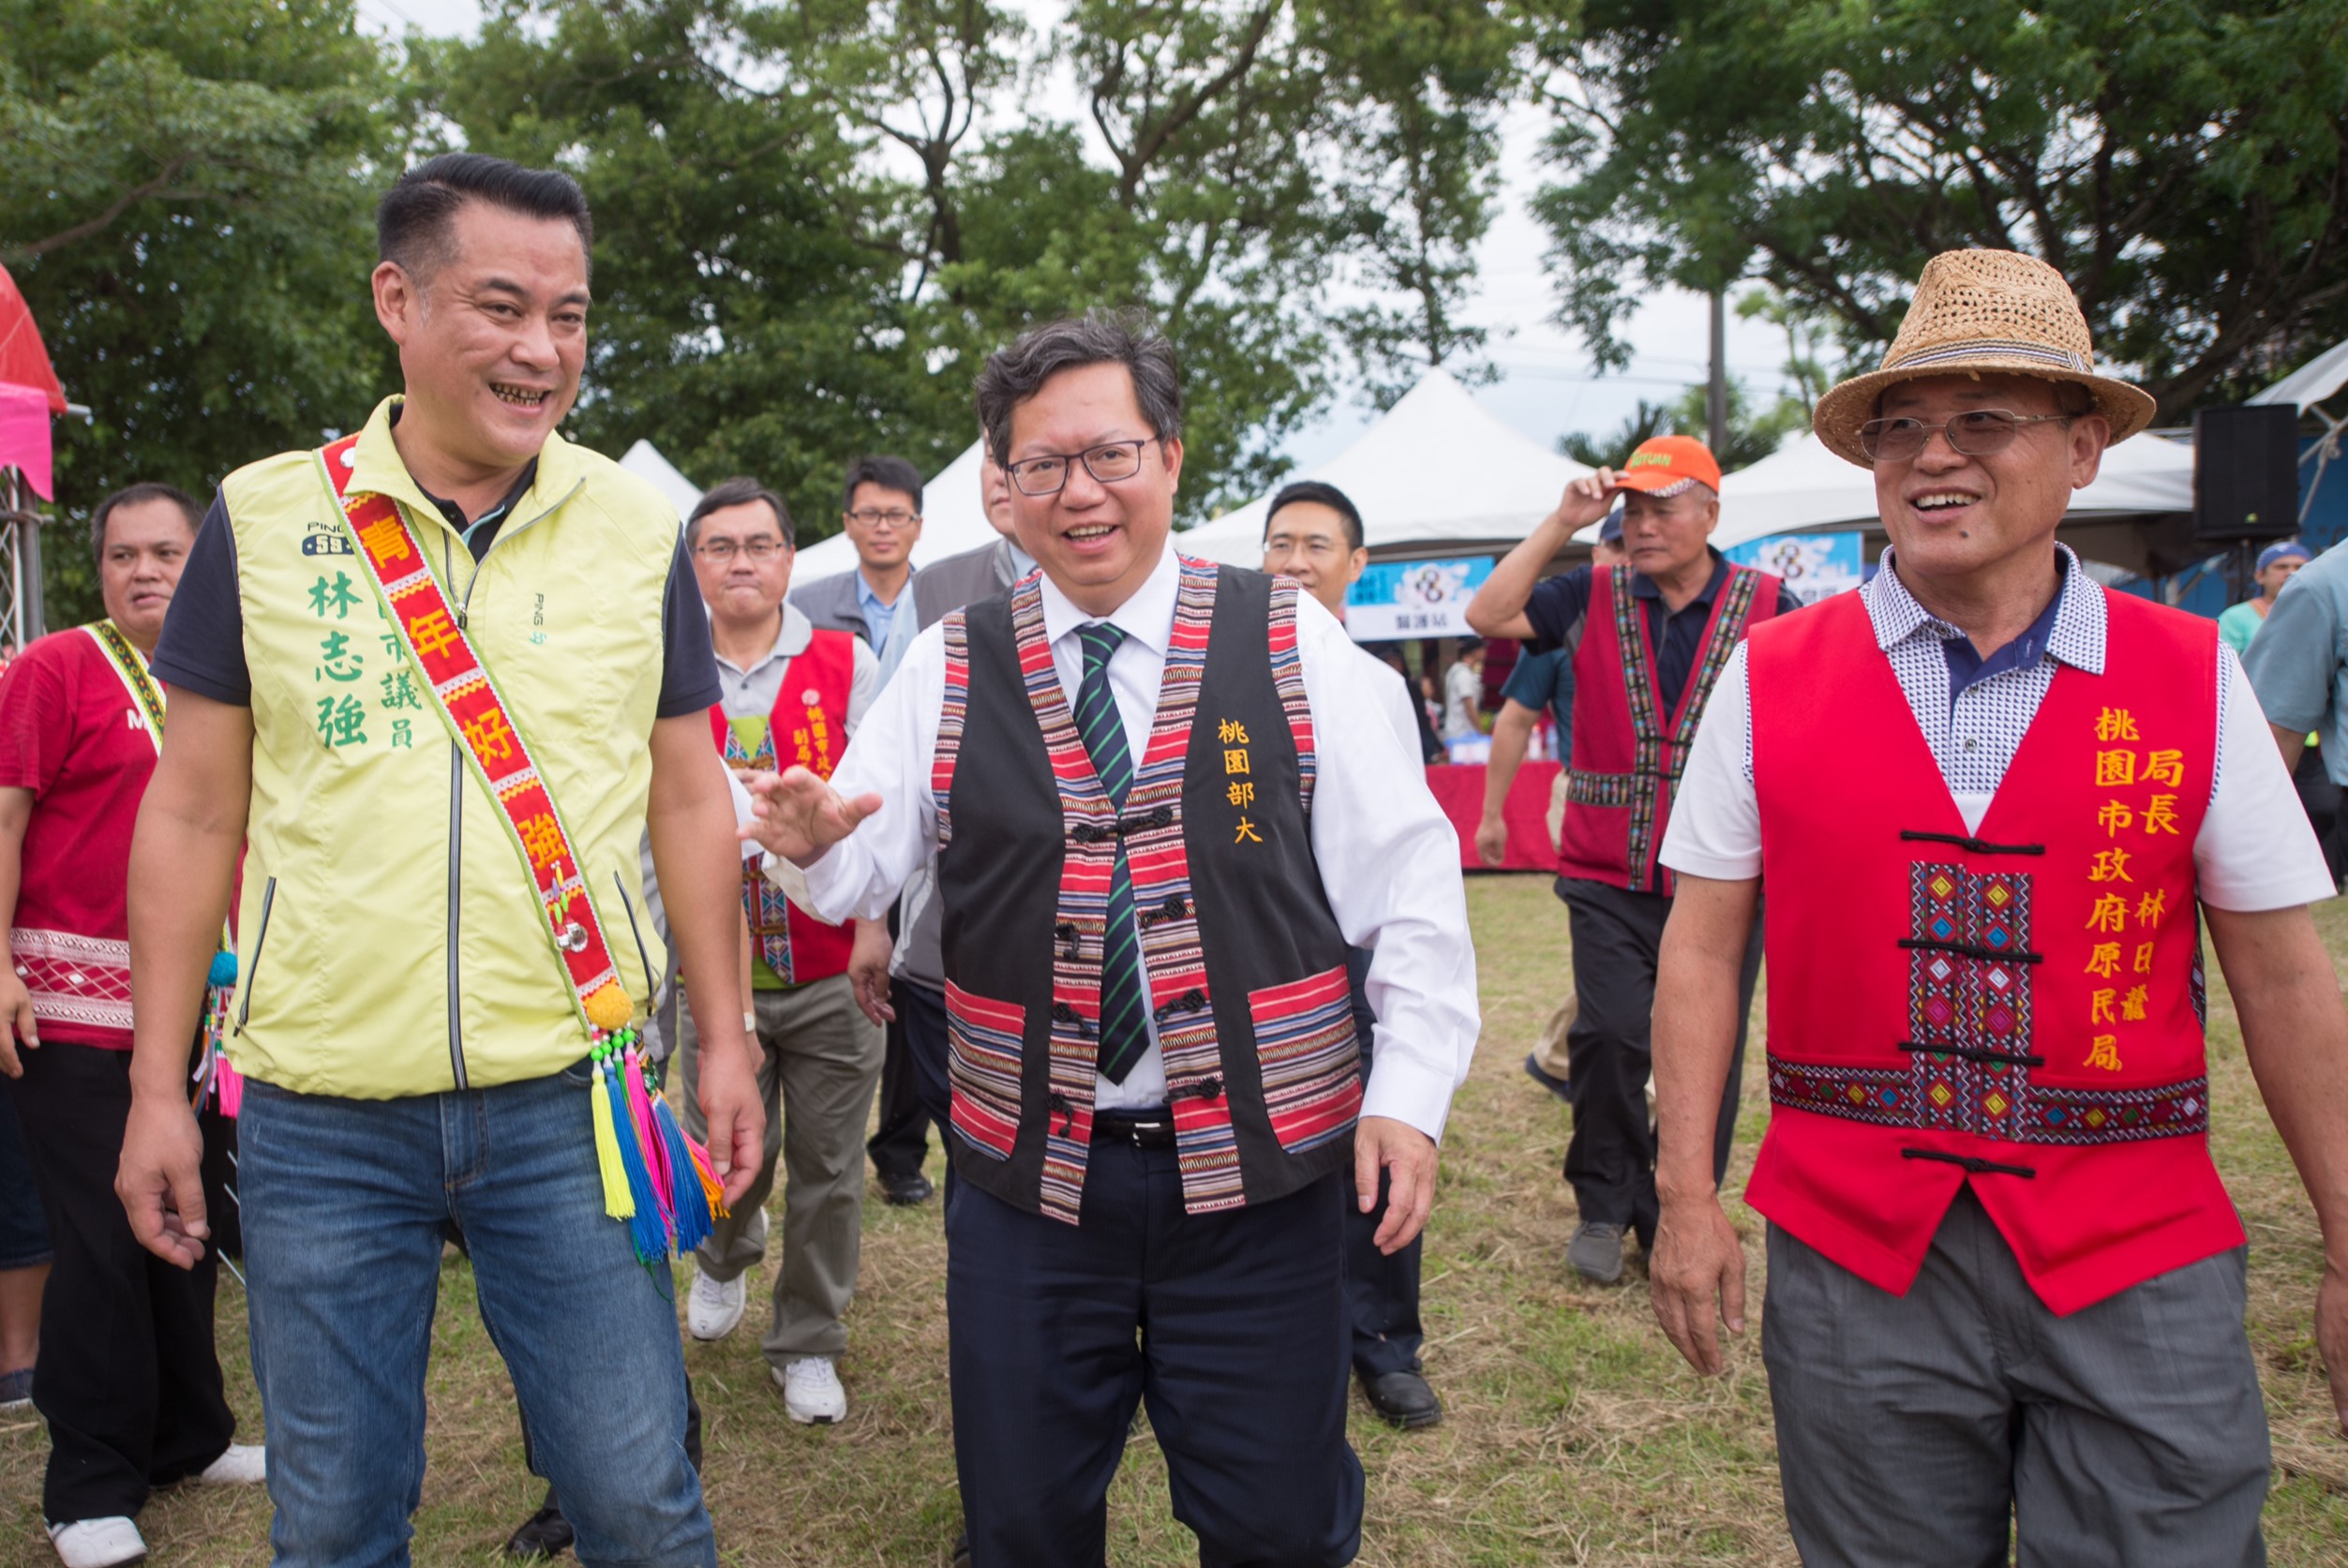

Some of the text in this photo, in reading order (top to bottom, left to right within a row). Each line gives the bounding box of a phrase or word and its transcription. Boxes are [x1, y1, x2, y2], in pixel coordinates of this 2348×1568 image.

[315, 534, 344, 554] 59
[307, 570, 368, 750] 林志強
[533, 592, 545, 626] PING
[358, 514, 567, 871] 青年好強
[377, 600, 424, 750] 市議員
[792, 726, 813, 769] 副局
[1218, 718, 1264, 844] 桃園部大
[2138, 749, 2185, 836] 局長
[2083, 706, 2140, 1072] 桃園市政府原民局
